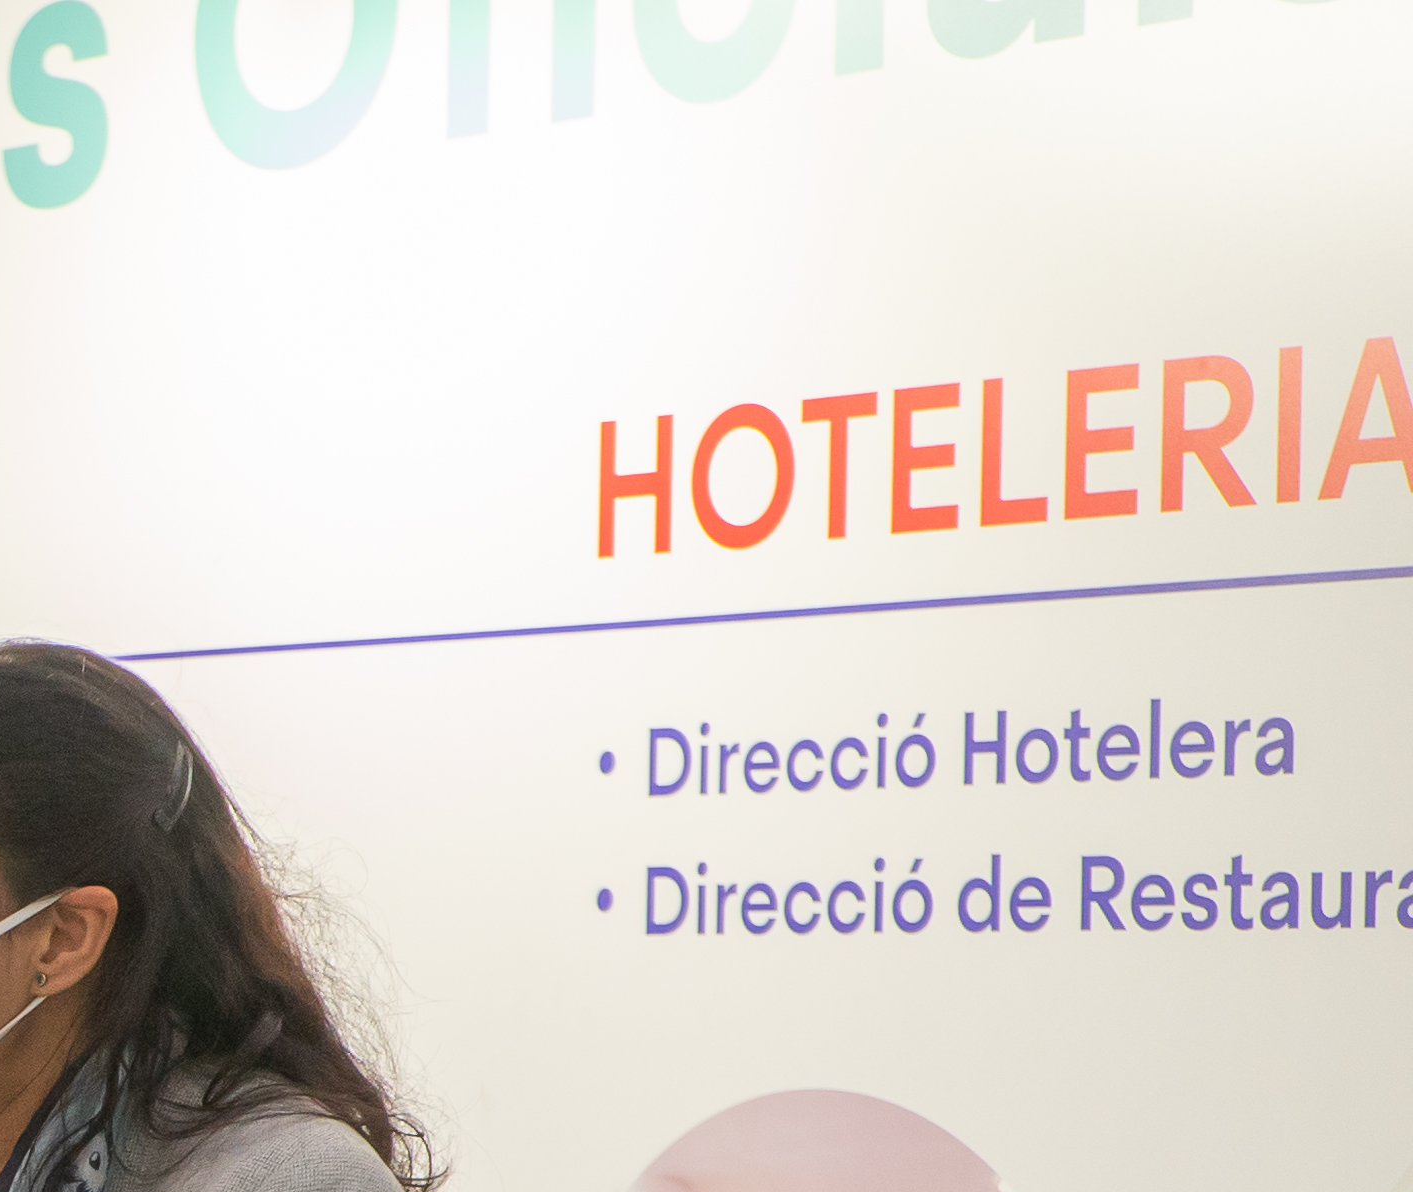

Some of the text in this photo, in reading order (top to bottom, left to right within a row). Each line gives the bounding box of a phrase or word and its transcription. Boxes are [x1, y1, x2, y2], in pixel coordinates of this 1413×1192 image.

[597, 335, 1413, 558] HOTELERIA
[646, 698, 1296, 797] Direcció Hotelera
[644, 857, 935, 936] Direcció
[957, 853, 1053, 933] de
